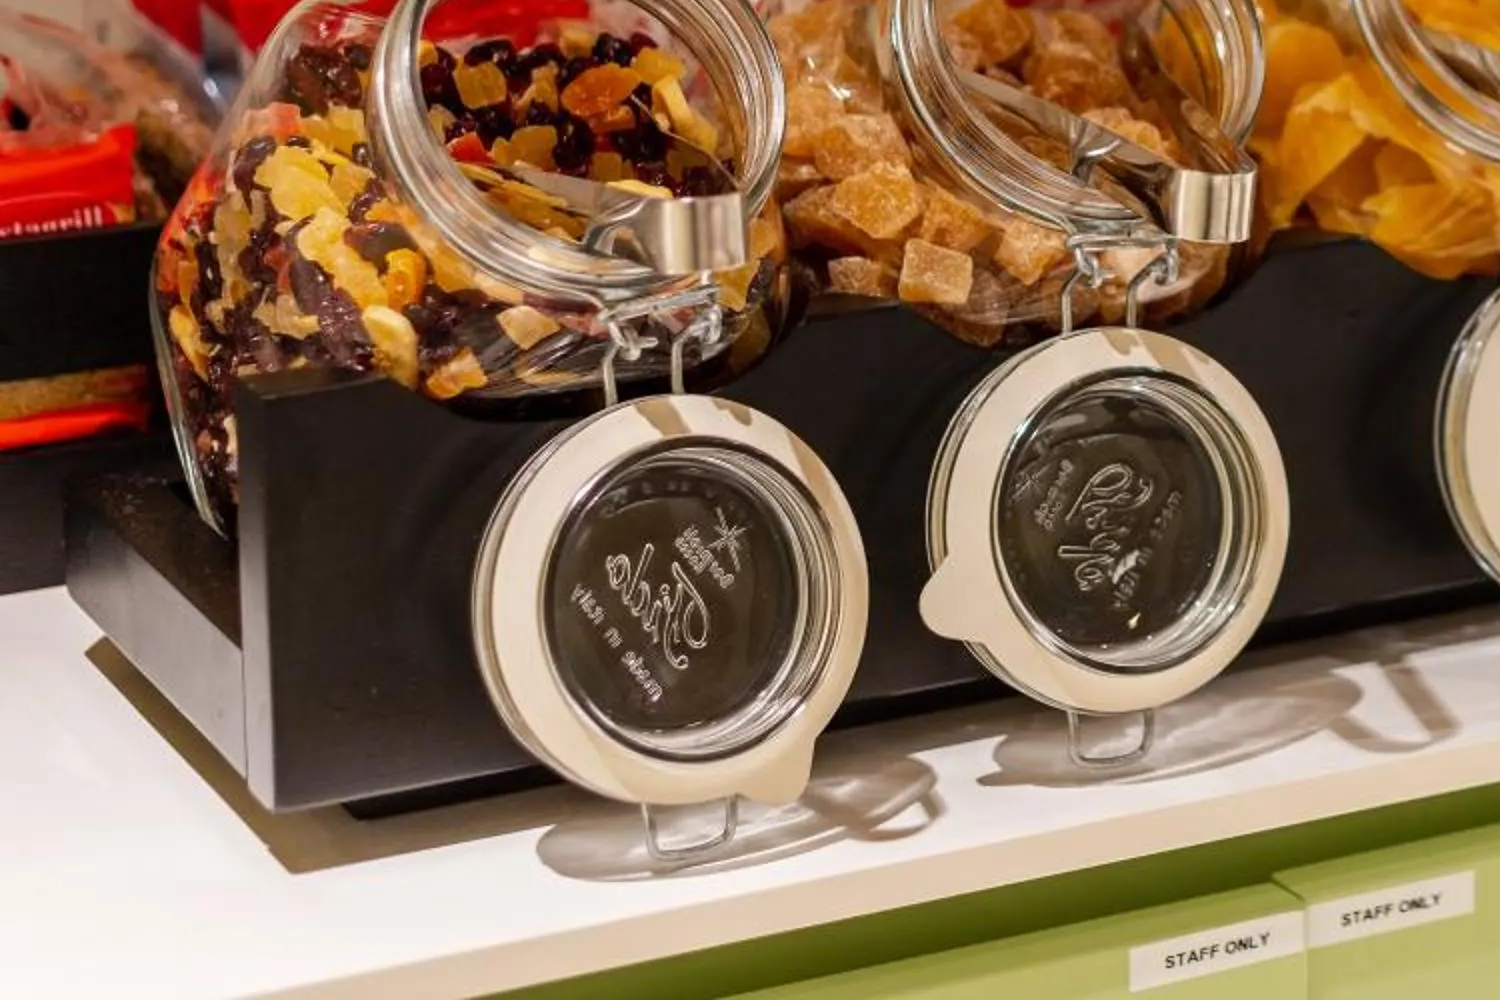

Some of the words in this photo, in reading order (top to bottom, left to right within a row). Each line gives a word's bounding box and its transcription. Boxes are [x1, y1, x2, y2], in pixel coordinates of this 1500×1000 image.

[1341, 902, 1393, 928] STAFF
[1399, 893, 1442, 913] ONLY
[1164, 942, 1220, 969] STAFF
[1225, 931, 1271, 954] ONLY
